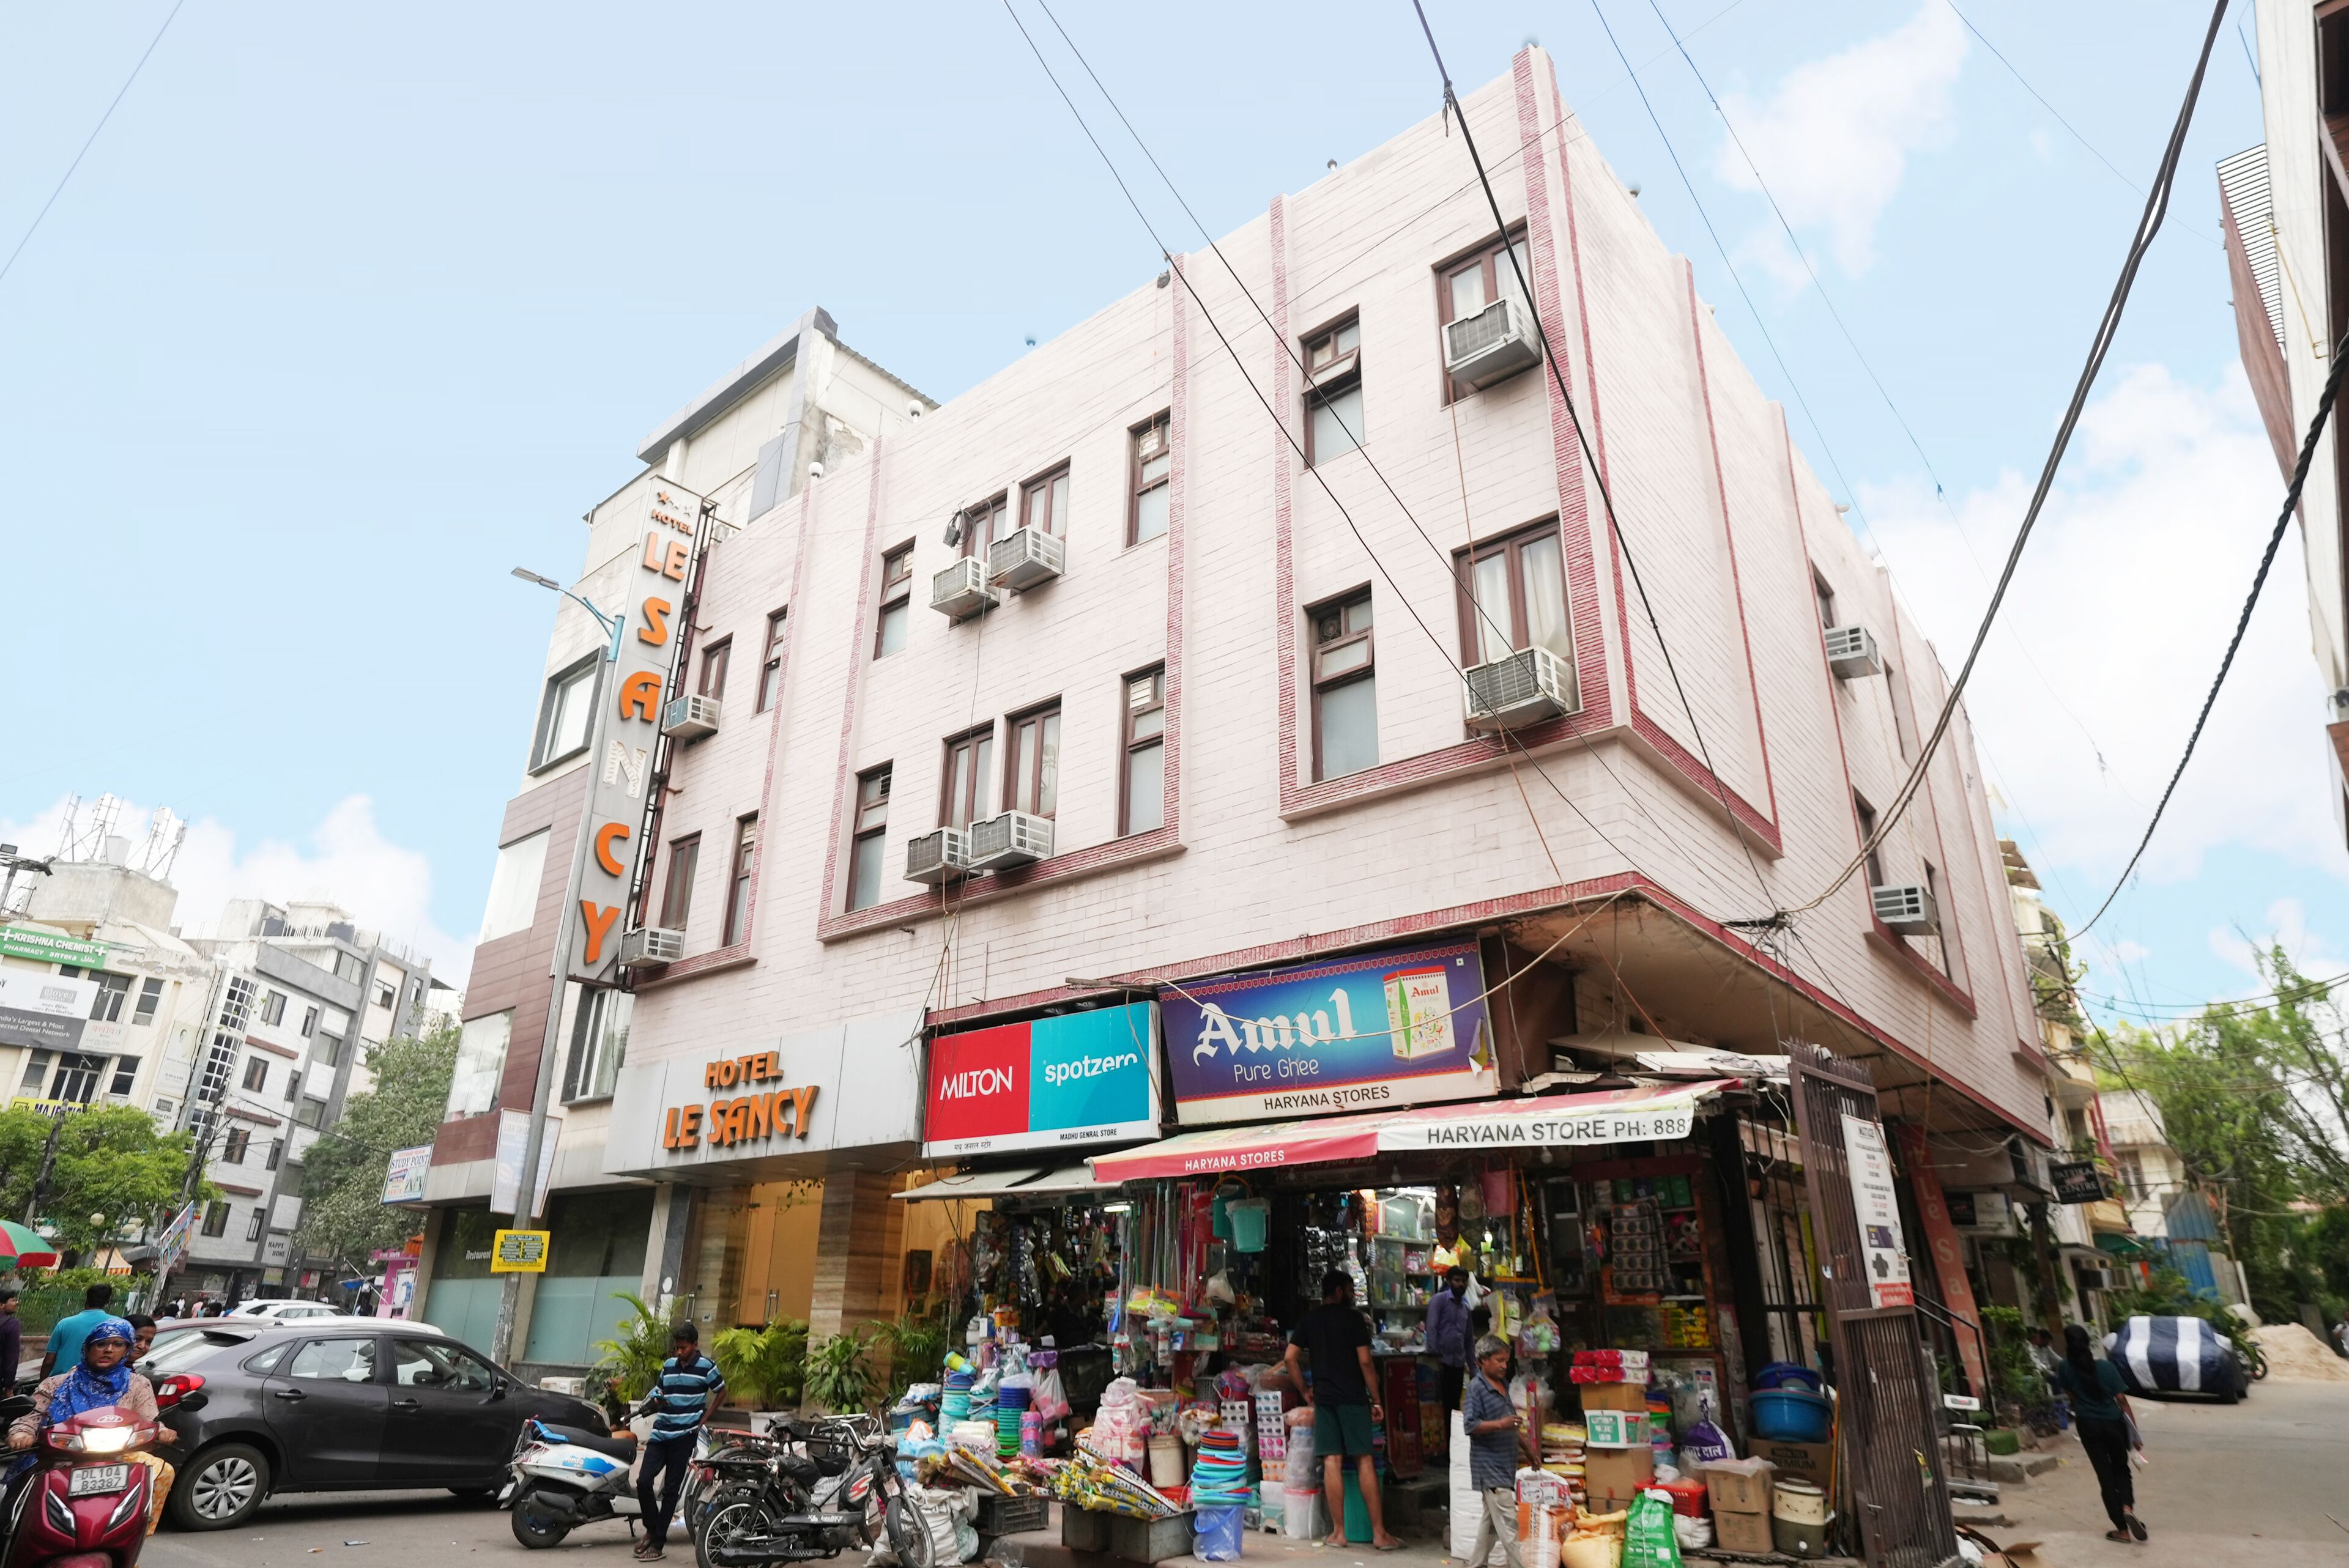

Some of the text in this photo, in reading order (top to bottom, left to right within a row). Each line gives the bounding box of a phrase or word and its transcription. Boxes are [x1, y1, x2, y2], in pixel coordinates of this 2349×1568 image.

[651, 508, 694, 537] HOTEL
[642, 531, 689, 583] LE
[579, 596, 672, 966] SANCY
[4, 944, 44, 955] PHARMACY
[13, 932, 95, 954] KRISHNA CHEMIST
[1411, 985, 1439, 998] Amul
[18, 1017, 41, 1028] Largest
[49, 1022, 65, 1030] Most
[20, 1024, 41, 1034] Dental
[42, 1029, 70, 1038] Network
[1193, 988, 1357, 1067] Amul
[705, 1051, 784, 1089] HOTEL
[1044, 1052, 1138, 1087] spotzero
[1233, 1059, 1319, 1082] Pure Ghee
[940, 1066, 1013, 1100] MILTON
[1264, 1086, 1390, 1110] HARYANA STORES
[663, 1085, 820, 1150] LE SANCY
[1427, 1124, 1526, 1144] HARYANA
[1532, 1120, 1606, 1141] STORE
[1614, 1121, 1647, 1136] PH:
[392, 1155, 429, 1169] STUDY POINT
[1186, 1157, 1236, 1172] HARYANA
[1241, 1150, 1285, 1166] STORES
[466, 1249, 491, 1260] Restaurant
[82, 1477, 121, 1490] B3387
